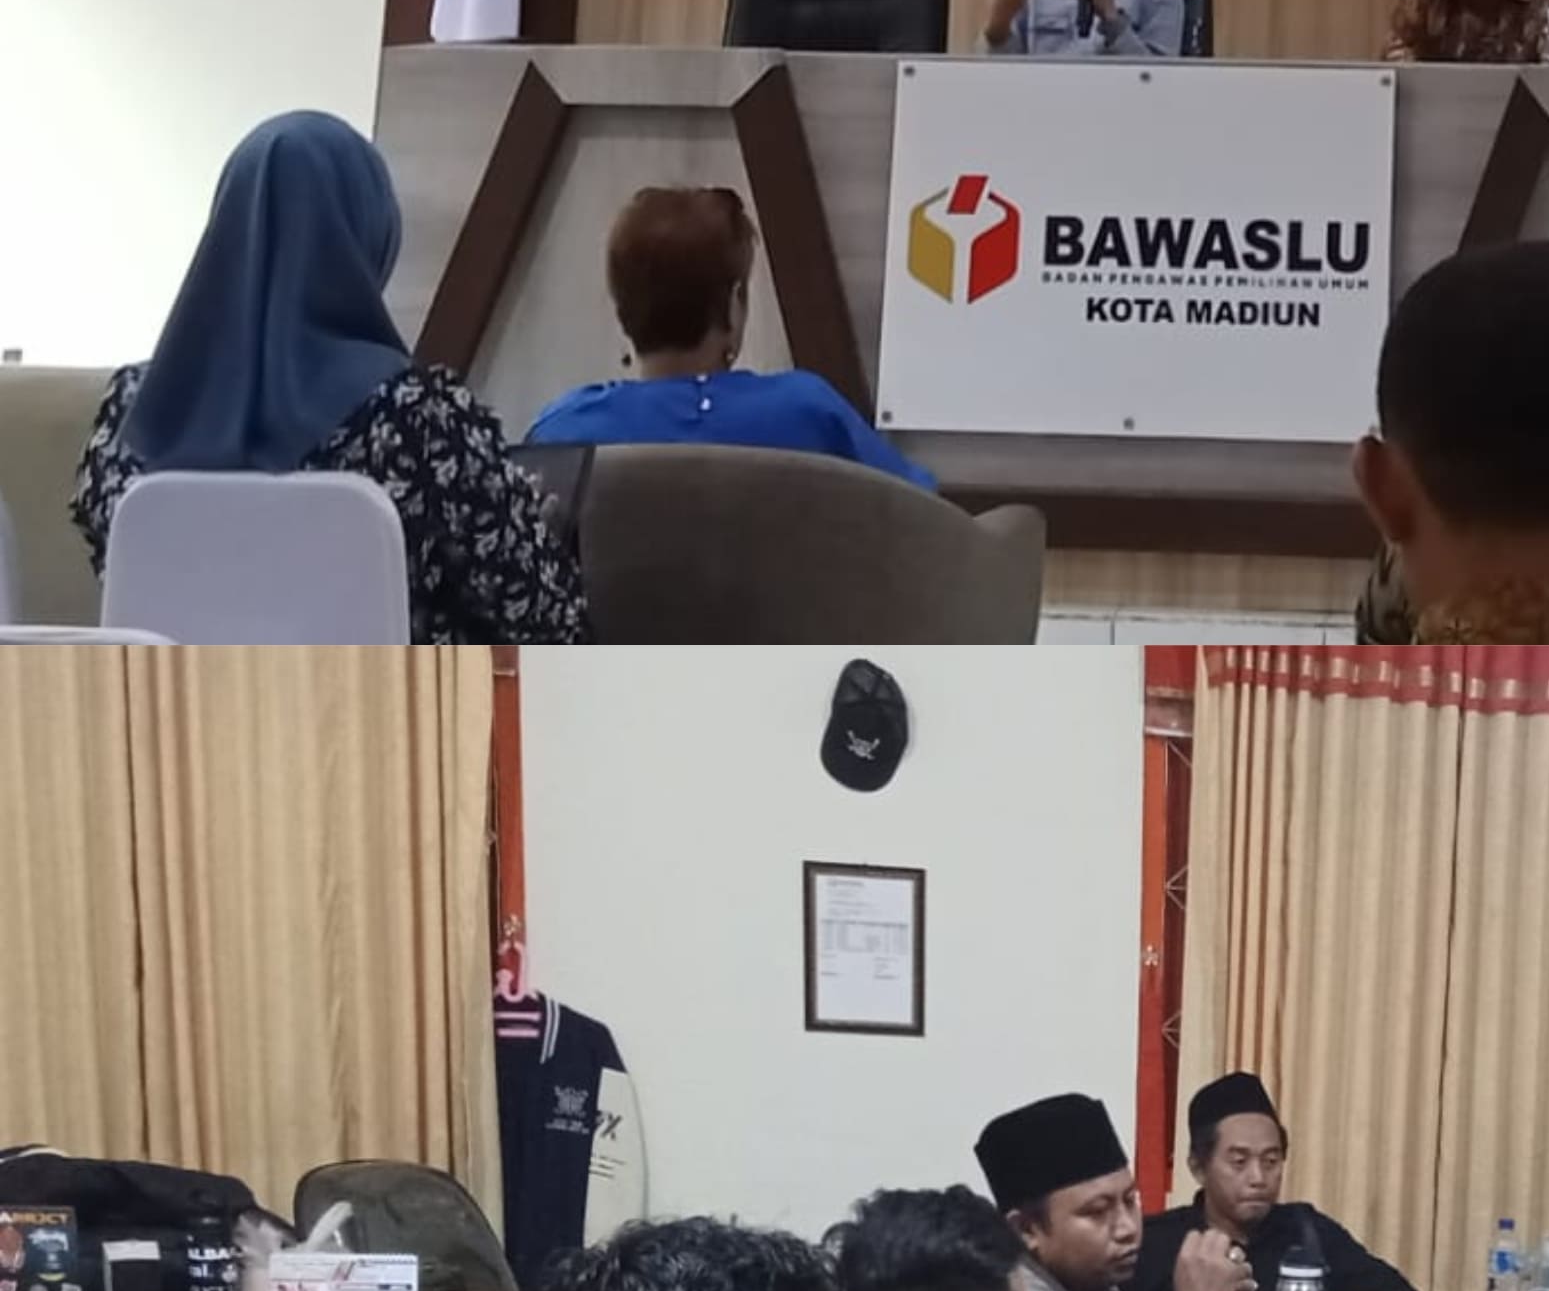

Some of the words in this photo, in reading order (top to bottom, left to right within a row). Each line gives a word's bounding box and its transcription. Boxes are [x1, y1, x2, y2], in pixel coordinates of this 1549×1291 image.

[1041, 214, 1371, 274] BAWASLU
[1042, 271, 1103, 285] BADAN
[1086, 297, 1175, 323] KOTA
[1185, 299, 1321, 327] MADIUN
